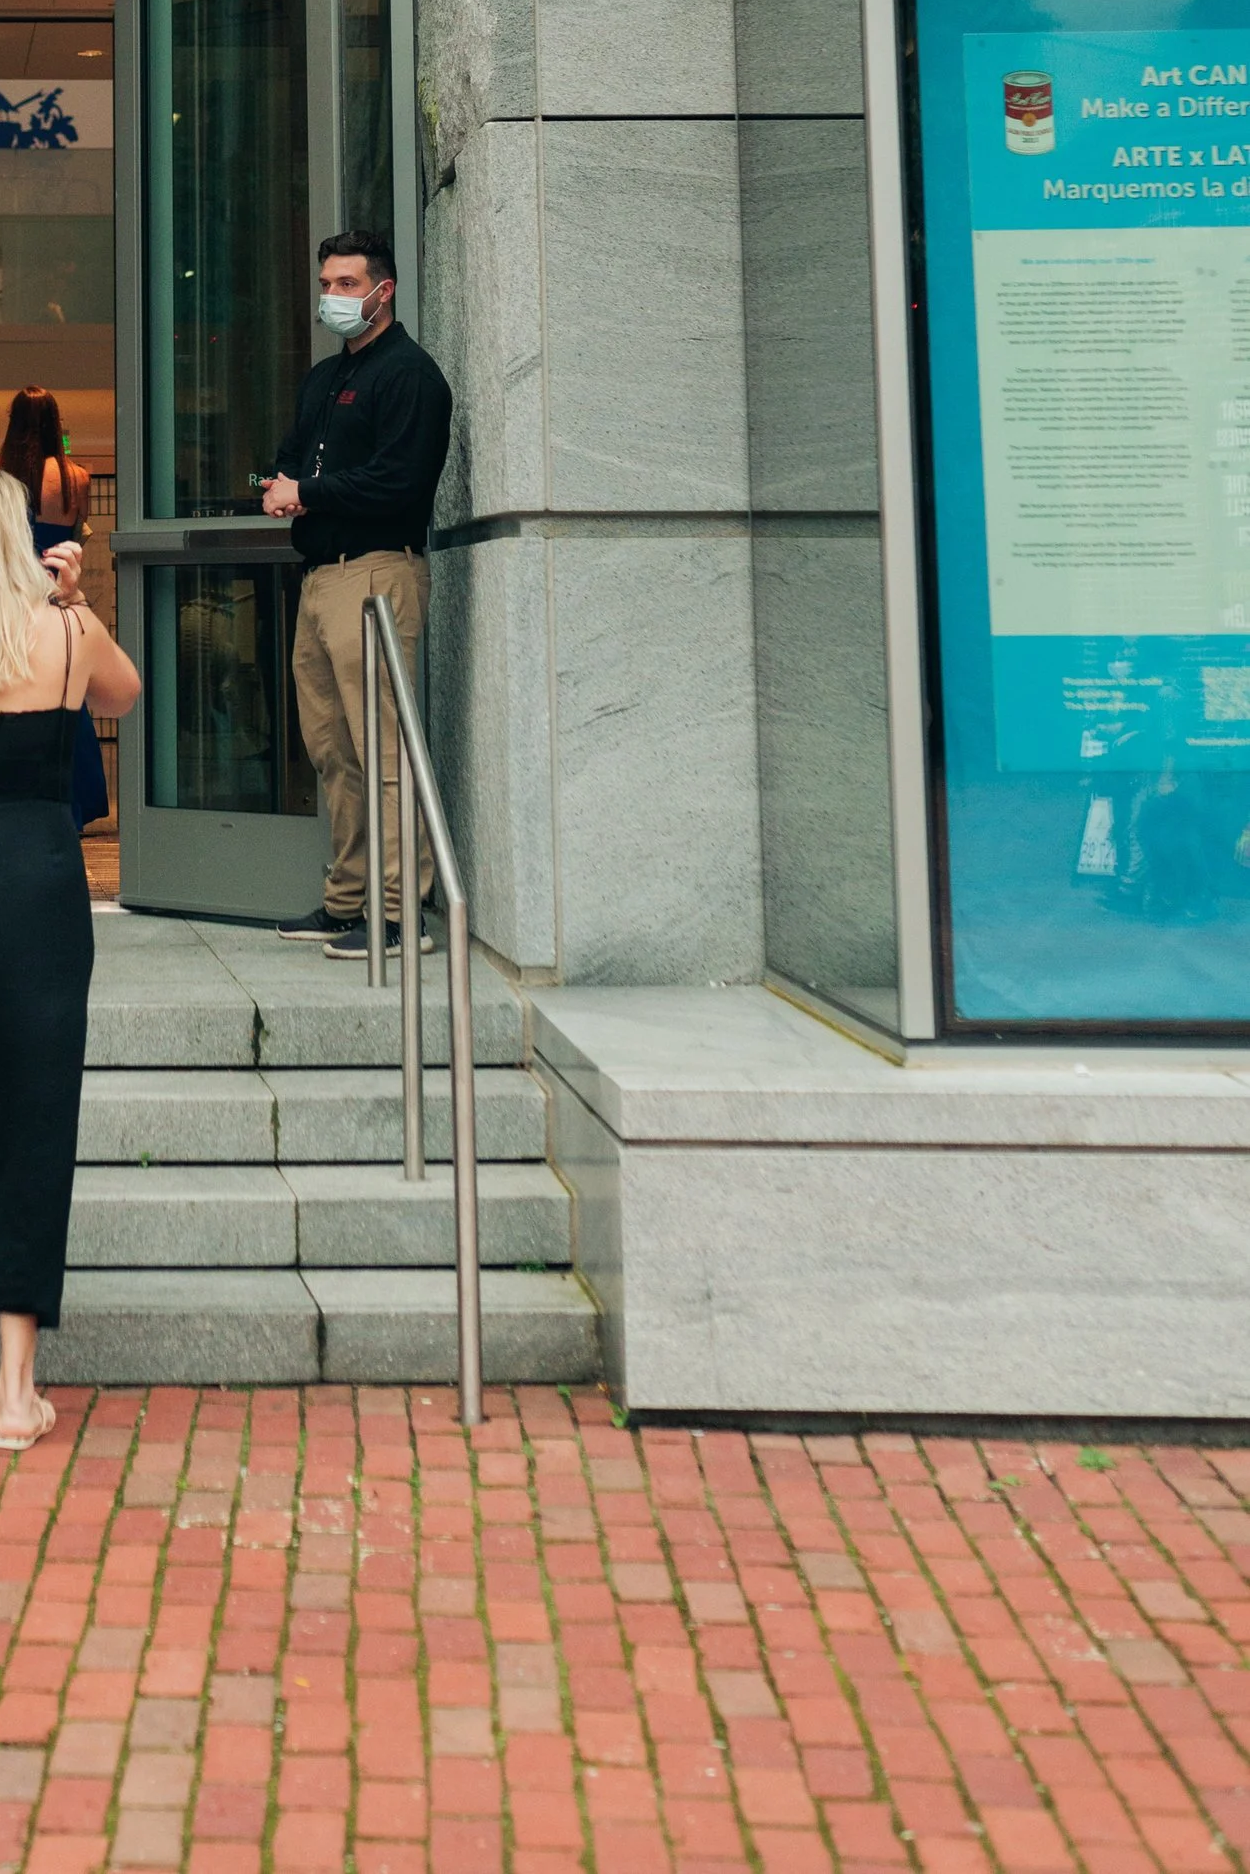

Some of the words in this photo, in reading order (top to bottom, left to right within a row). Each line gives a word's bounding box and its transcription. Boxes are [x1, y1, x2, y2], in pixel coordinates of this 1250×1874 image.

[1141, 65, 1183, 86] Art
[1188, 64, 1247, 86] CAN
[1081, 98, 1150, 119] Make
[1156, 101, 1171, 118] a
[1178, 96, 1250, 117] Differ
[1112, 145, 1183, 167] ARTE
[1188, 150, 1205, 166] x
[1043, 178, 1196, 203] Marquemos
[1201, 177, 1225, 198] la
